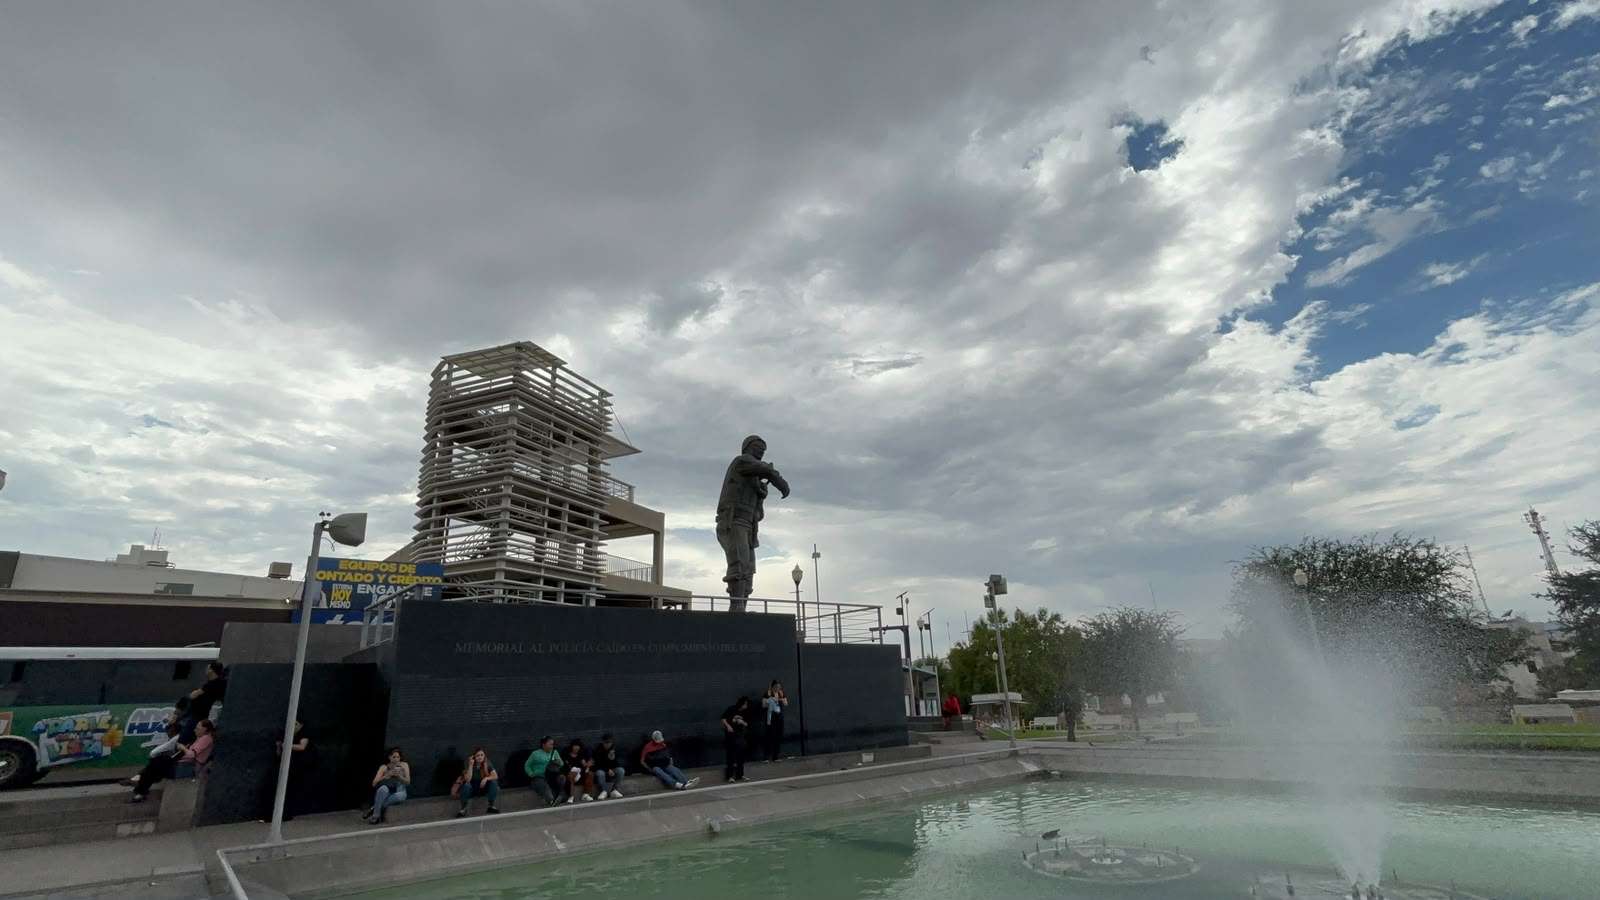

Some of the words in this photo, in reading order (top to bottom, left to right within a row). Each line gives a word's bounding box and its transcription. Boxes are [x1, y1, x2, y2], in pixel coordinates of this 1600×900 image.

[339, 560, 398, 573] EQUIPOS
[399, 562, 417, 574] DE
[315, 571, 374, 583] ONTADO
[379, 574, 386, 583] Y
[331, 589, 352, 601] HOY
[357, 583, 433, 597] ENGANE
[455, 641, 525, 654] MEMORIAL
[529, 641, 545, 653] AL
